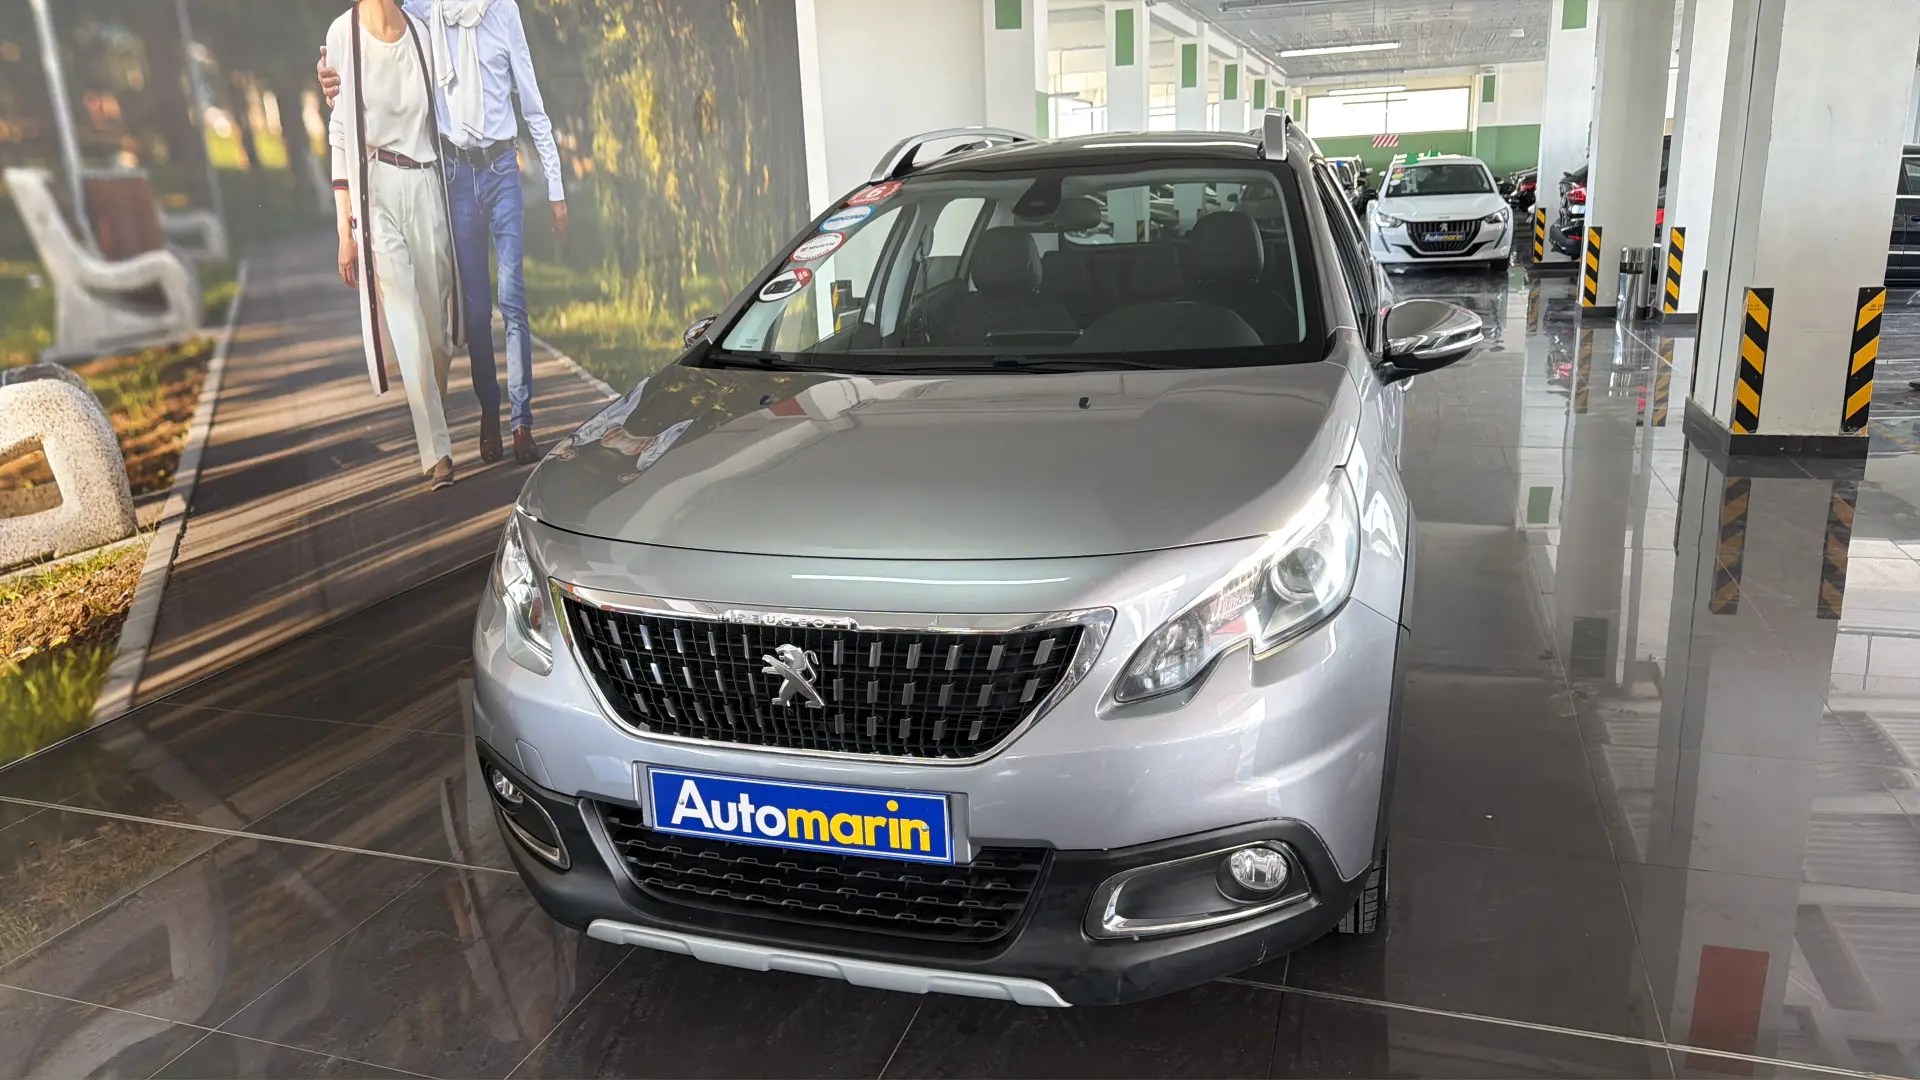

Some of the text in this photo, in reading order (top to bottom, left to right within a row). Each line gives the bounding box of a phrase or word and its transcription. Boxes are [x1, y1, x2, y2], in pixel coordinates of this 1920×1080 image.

[1424, 233, 1464, 241] Automarin
[736, 613, 841, 629] PEUGEOT
[670, 778, 931, 852] Automarin
